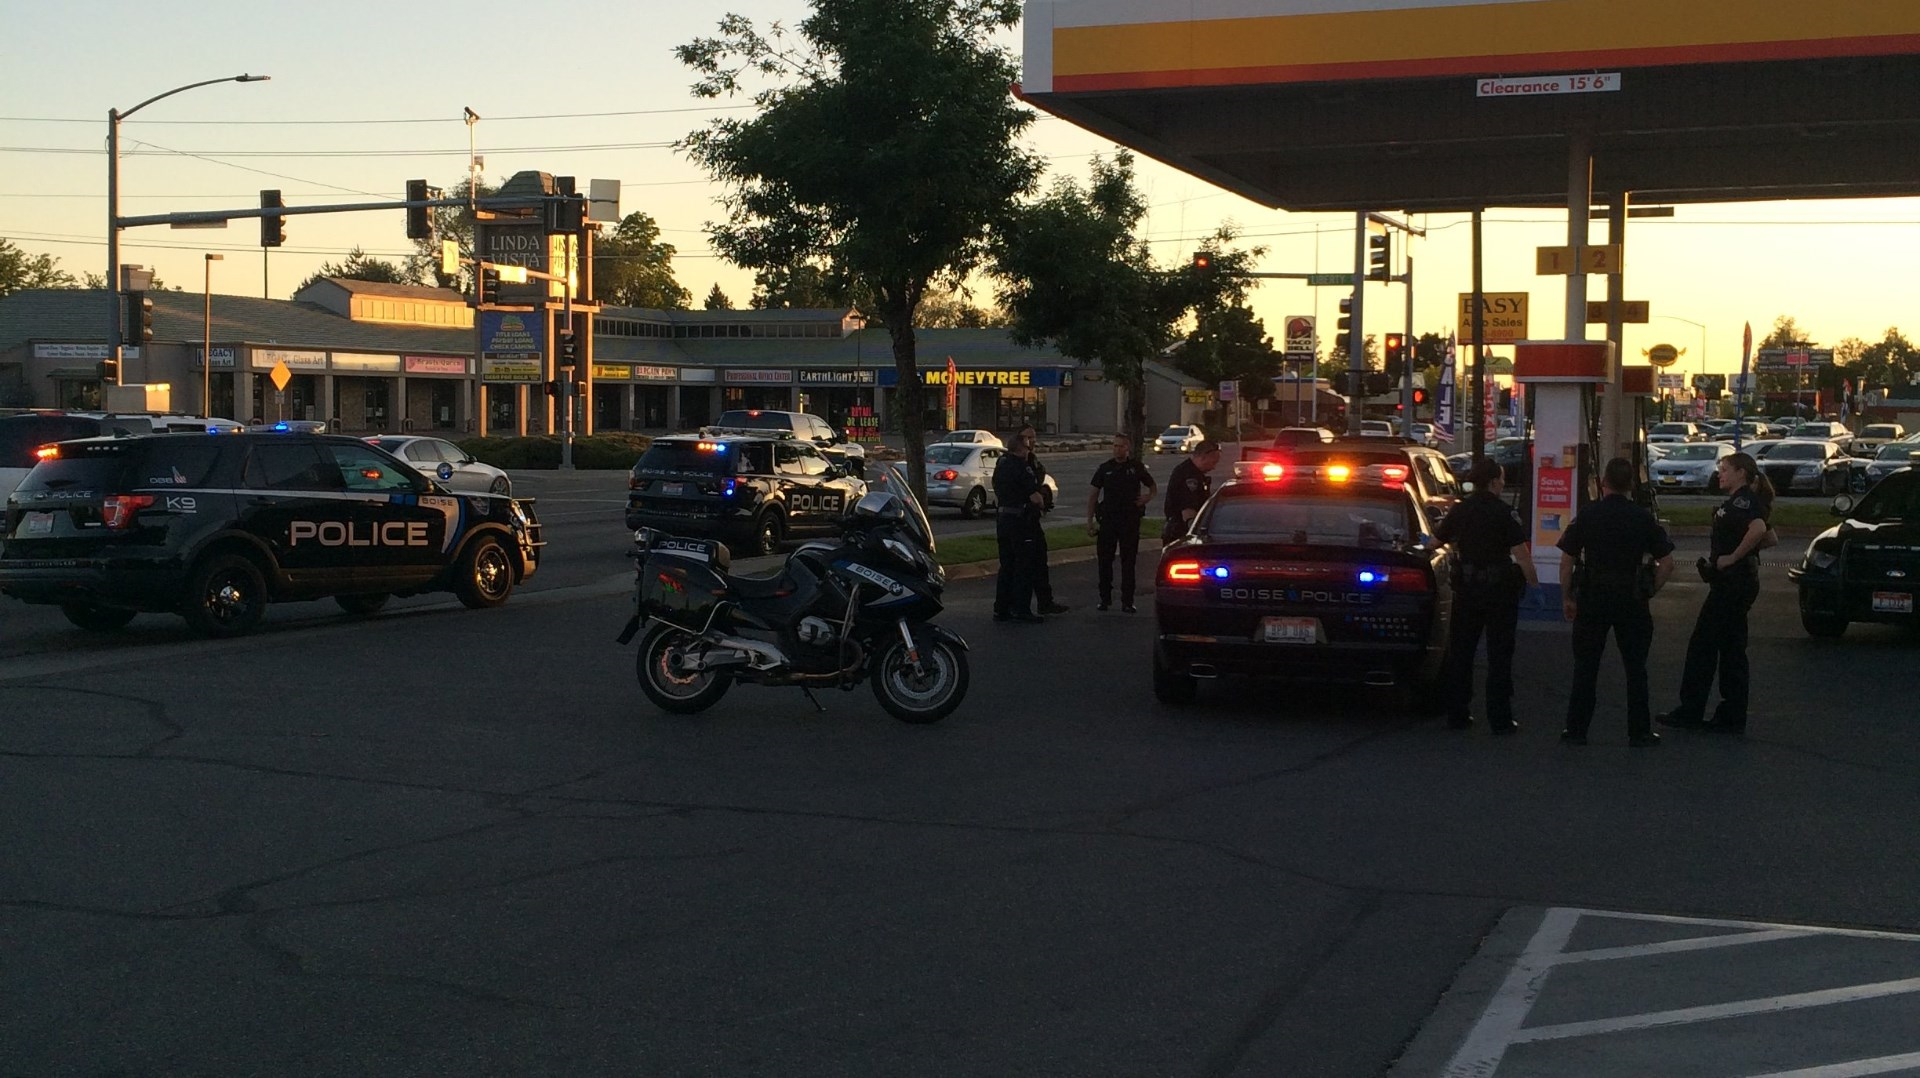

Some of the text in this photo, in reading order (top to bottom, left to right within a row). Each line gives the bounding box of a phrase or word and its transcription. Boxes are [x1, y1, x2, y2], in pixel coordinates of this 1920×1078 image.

[1480, 81, 1560, 95] Clearance
[491, 236, 540, 251] LINDA
[491, 253, 540, 268] VISTA
[1551, 252, 1559, 269] 1
[1592, 249, 1606, 268] 2
[1463, 298, 1524, 314] EASY
[1463, 317, 1523, 327] Ao Sales
[926, 371, 1030, 385] MONEYTREE
[860, 417, 879, 427] LEASE
[1540, 476, 1565, 486] Save
[166, 496, 196, 509] K9
[422, 497, 454, 507] BOISE
[791, 494, 840, 511] POLICE
[290, 520, 429, 546] POLICE
[658, 541, 707, 553] POLICE
[856, 566, 892, 586] BOISE
[1219, 588, 1373, 604] BOISE POLICE
